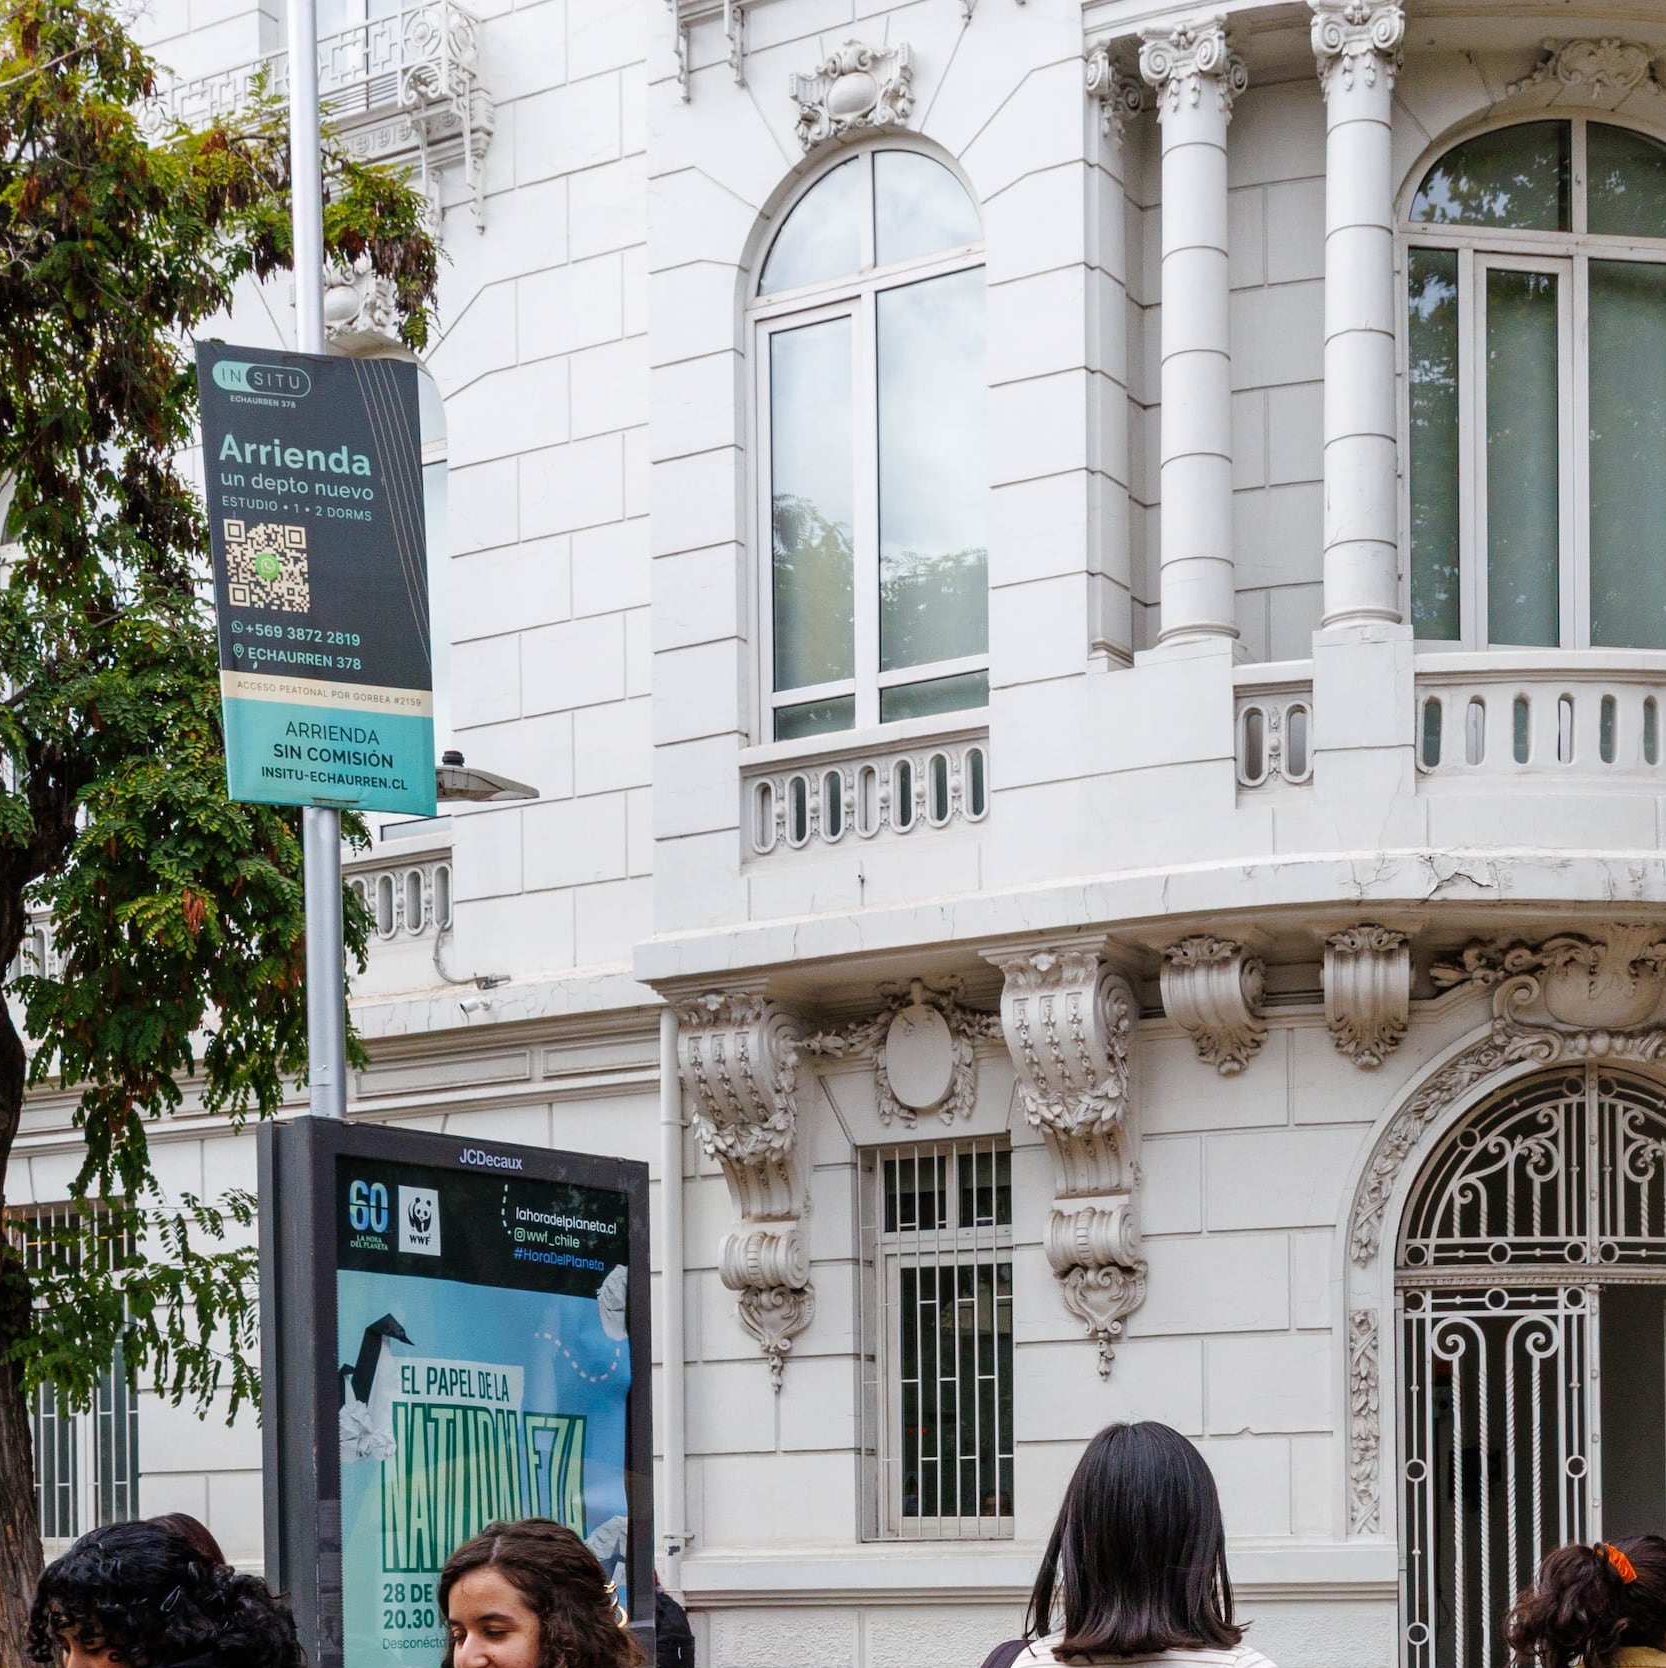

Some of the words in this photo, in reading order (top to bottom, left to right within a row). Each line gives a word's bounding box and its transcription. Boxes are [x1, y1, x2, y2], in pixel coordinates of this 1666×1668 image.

[229, 395, 279, 407] ECHAURREN
[281, 400, 297, 409] 378
[219, 433, 372, 477] Arrienda
[220, 472, 245, 487] un
[251, 472, 309, 495] depto
[315, 482, 374, 501] nuevo
[222, 495, 278, 512] ESTUDIO
[315, 506, 323, 517] 2
[327, 507, 372, 522] DORMS
[246, 623, 283, 639] +569
[287, 626, 322, 644] 3872
[326, 631, 361, 647] 2819
[248, 647, 333, 668] ECHAURREN
[336, 656, 362, 671] 378
[237, 680, 276, 693] ACCESO
[279, 684, 329, 698] PEATONAL
[331, 690, 350, 700] POR
[353, 692, 391, 705] GORBEA
[393, 696, 422, 708] #2159
[285, 720, 381, 746] ARRIENDA
[273, 743, 302, 761] SIN
[307, 747, 394, 769] COMISIÓN
[261, 765, 409, 791] INSITU-ECHAURREN.CL
[459, 1148, 523, 1171] JCDecaux
[348, 1179, 389, 1234] 60
[515, 1206, 617, 1236] lahoradelplaneta.cl
[350, 1240, 363, 1249] DEL
[363, 1241, 389, 1251] PLANETA
[409, 1234, 431, 1246] WWF
[526, 1230, 581, 1249] wwf_chile
[513, 1247, 605, 1272] #HoraDelPlaneta
[401, 1365, 420, 1395] EL
[426, 1366, 476, 1399] PAPEL
[478, 1370, 493, 1400] DE
[494, 1372, 510, 1402] LA
[383, 1583, 406, 1603] 28
[410, 1583, 433, 1603] DE
[383, 1608, 435, 1630] 20.30
[382, 1636, 447, 1650] Desconécta
